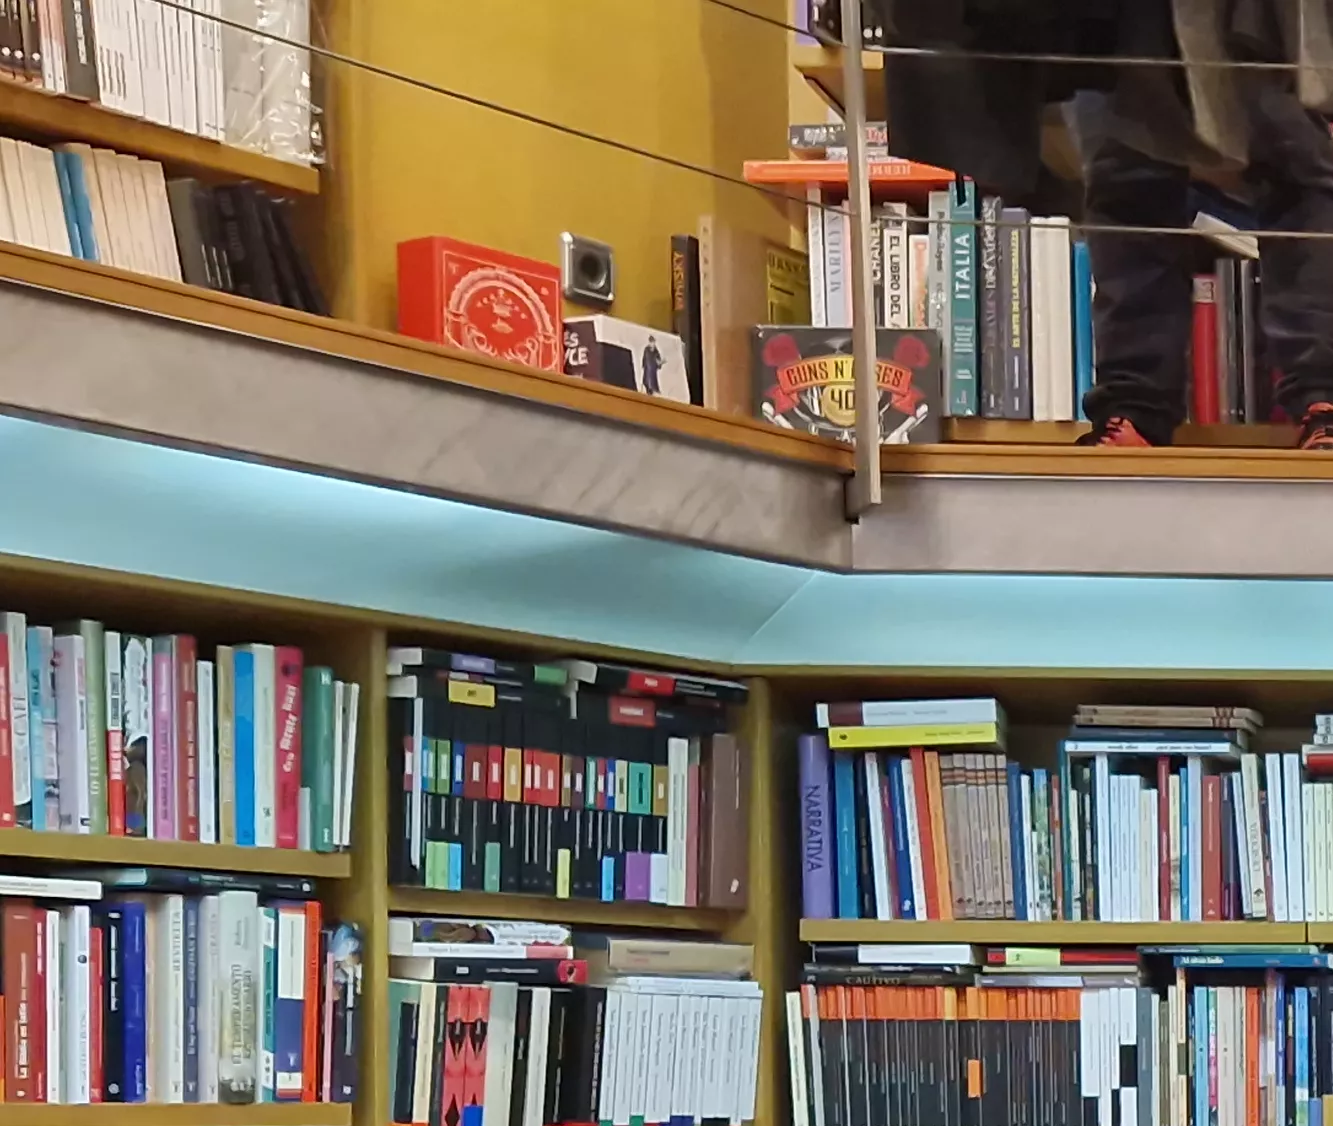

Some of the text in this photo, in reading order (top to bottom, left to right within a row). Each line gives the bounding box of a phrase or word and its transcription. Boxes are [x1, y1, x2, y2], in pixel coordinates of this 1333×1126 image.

[673, 250, 685, 312] WHISKY
[888, 235, 902, 318] EL LIBRO DEL
[955, 232, 972, 300] ITALIA
[786, 359, 829, 388] GUNS
[805, 784, 824, 874] NARRATIVA
